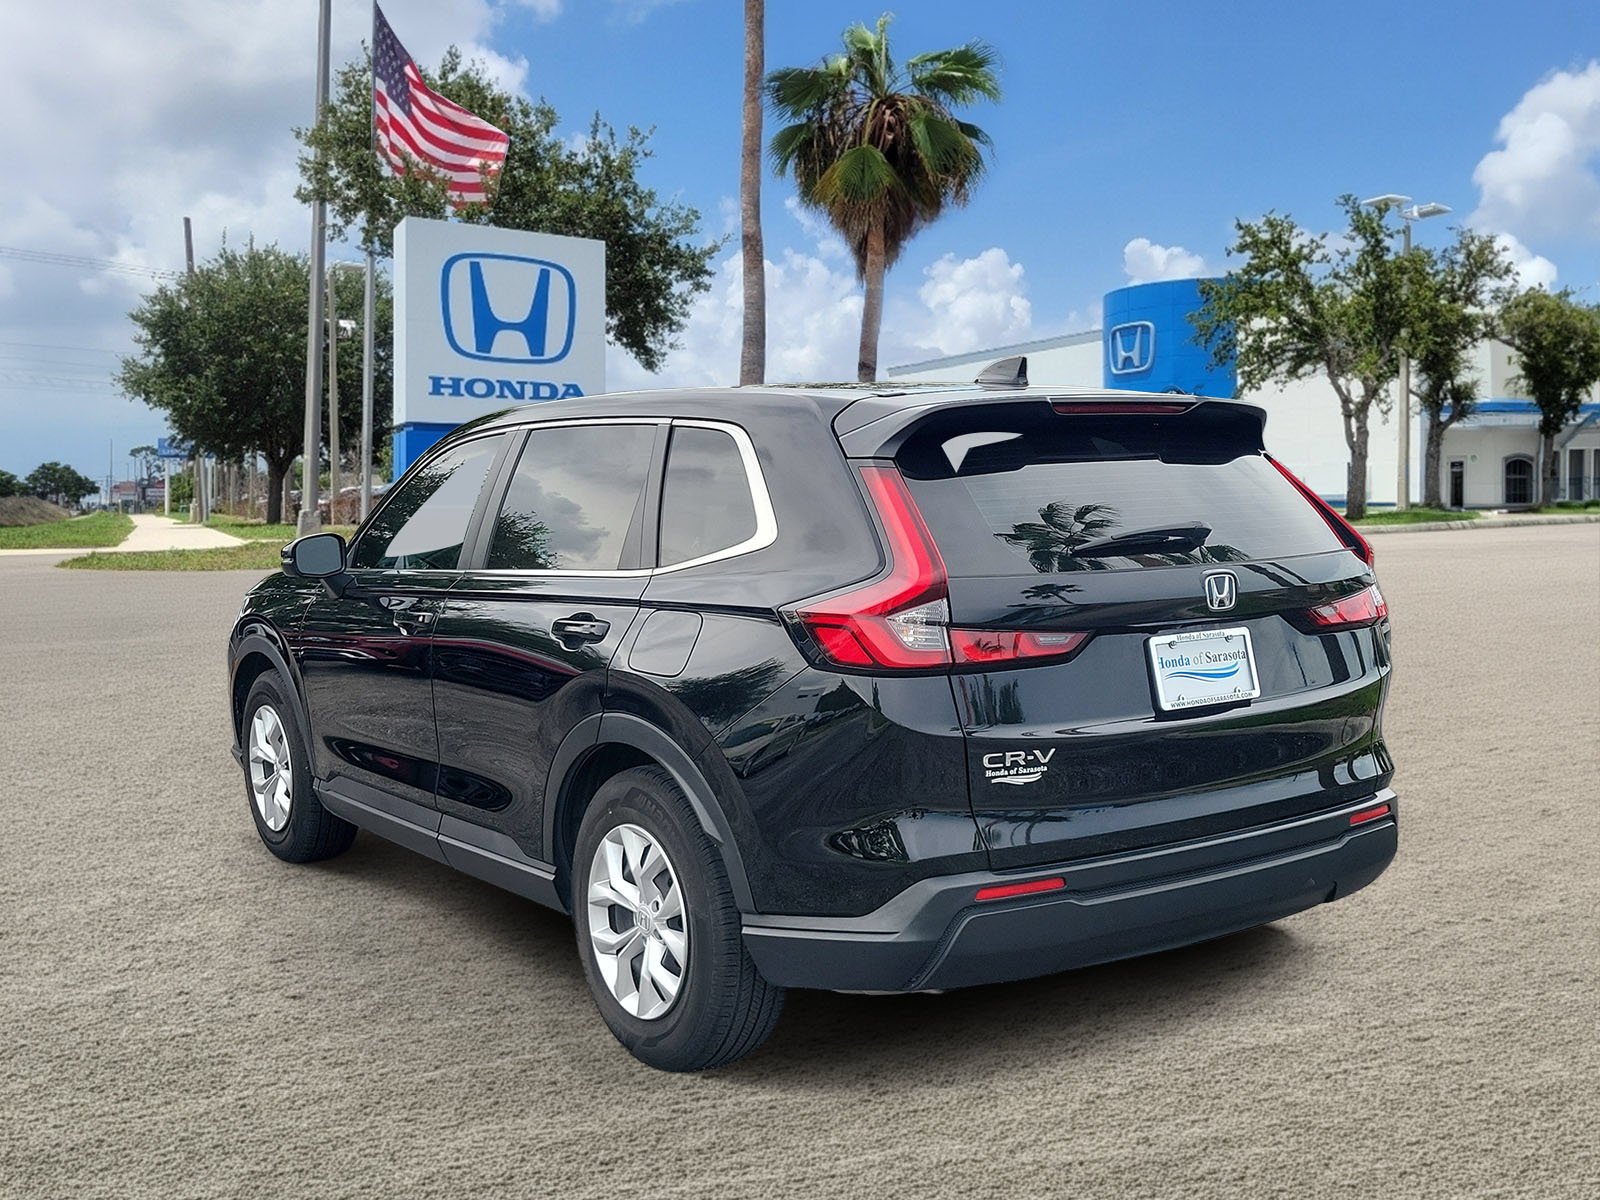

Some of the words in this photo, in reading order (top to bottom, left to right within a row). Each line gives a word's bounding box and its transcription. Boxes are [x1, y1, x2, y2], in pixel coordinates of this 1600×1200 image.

[428, 375, 585, 401] HONDA
[1193, 651, 1203, 665] of
[1205, 649, 1247, 664] Sarasota
[983, 748, 1056, 768] CR-V
[985, 769, 1009, 777] Honda
[1009, 767, 1018, 775] of
[1018, 765, 1048, 774] Sarasota
